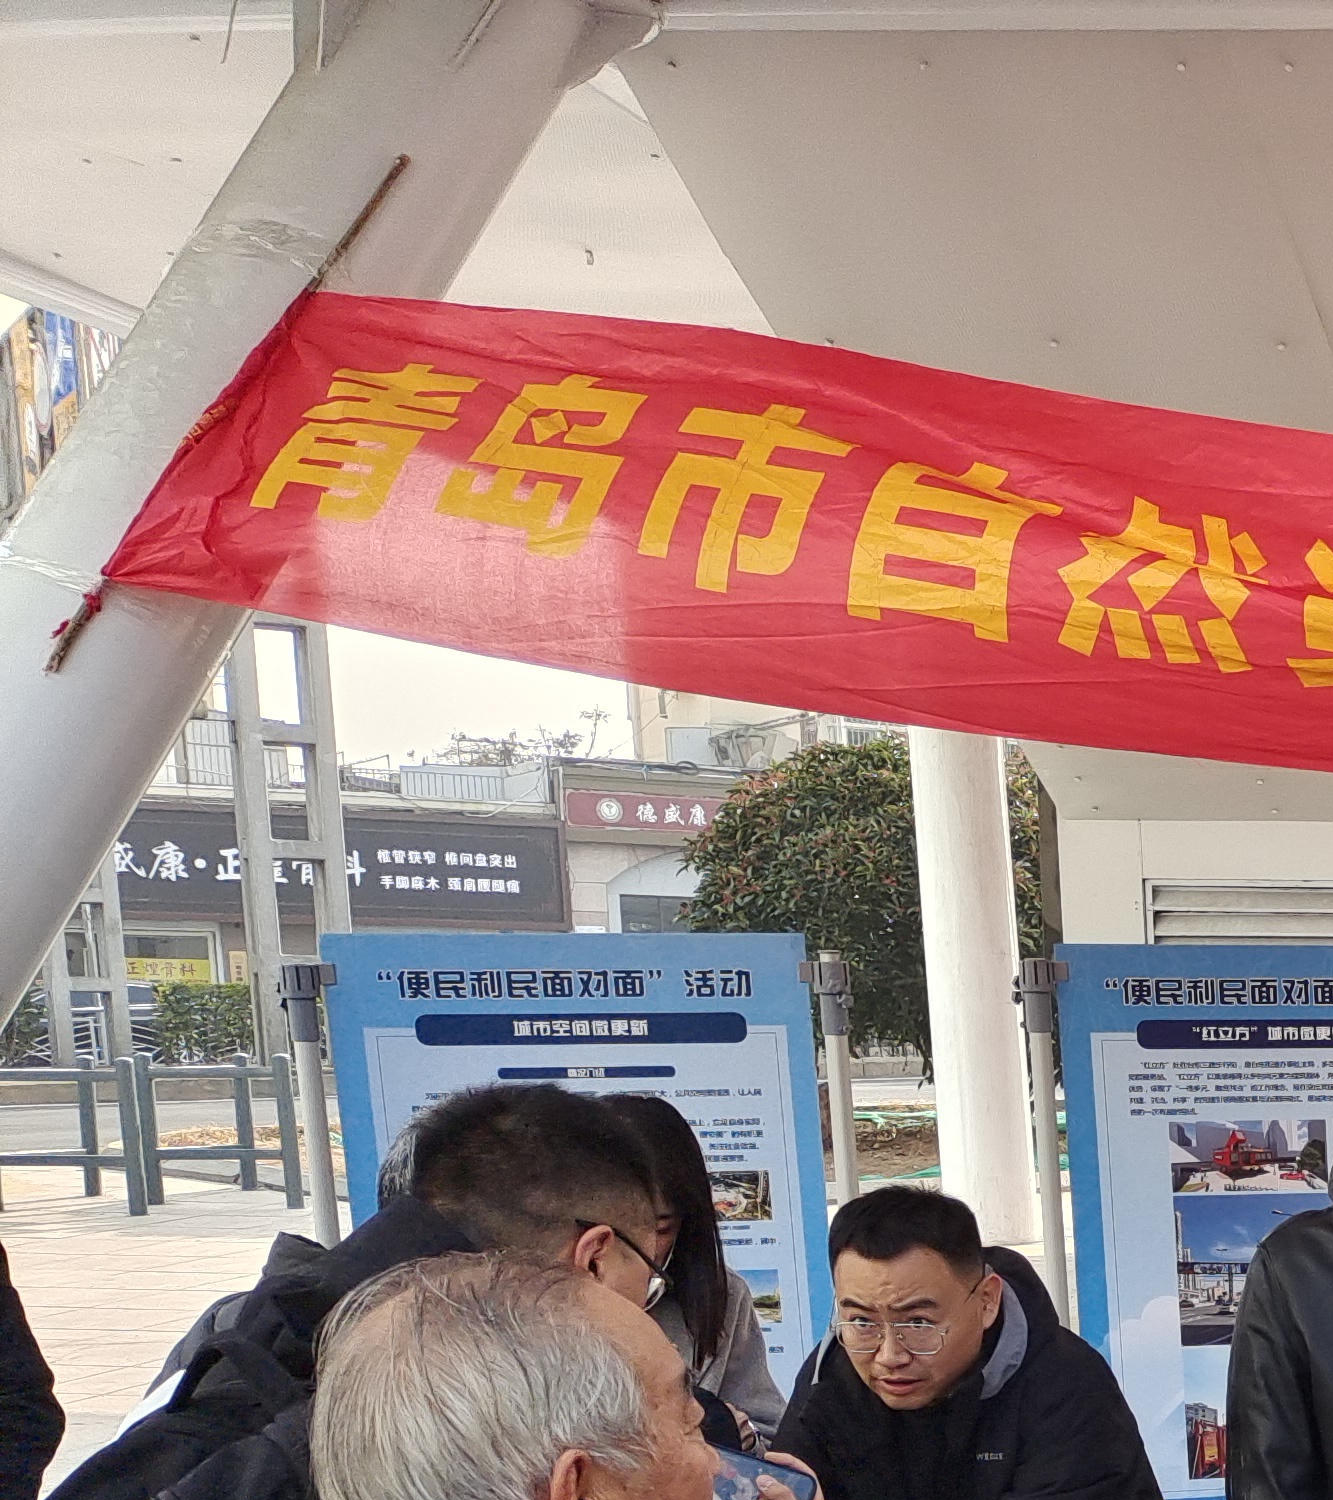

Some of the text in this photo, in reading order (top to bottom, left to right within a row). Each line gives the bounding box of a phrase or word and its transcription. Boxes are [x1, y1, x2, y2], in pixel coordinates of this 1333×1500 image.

[684, 969, 752, 998] 活动
[513, 1020, 648, 1037] 城市空间微更新
